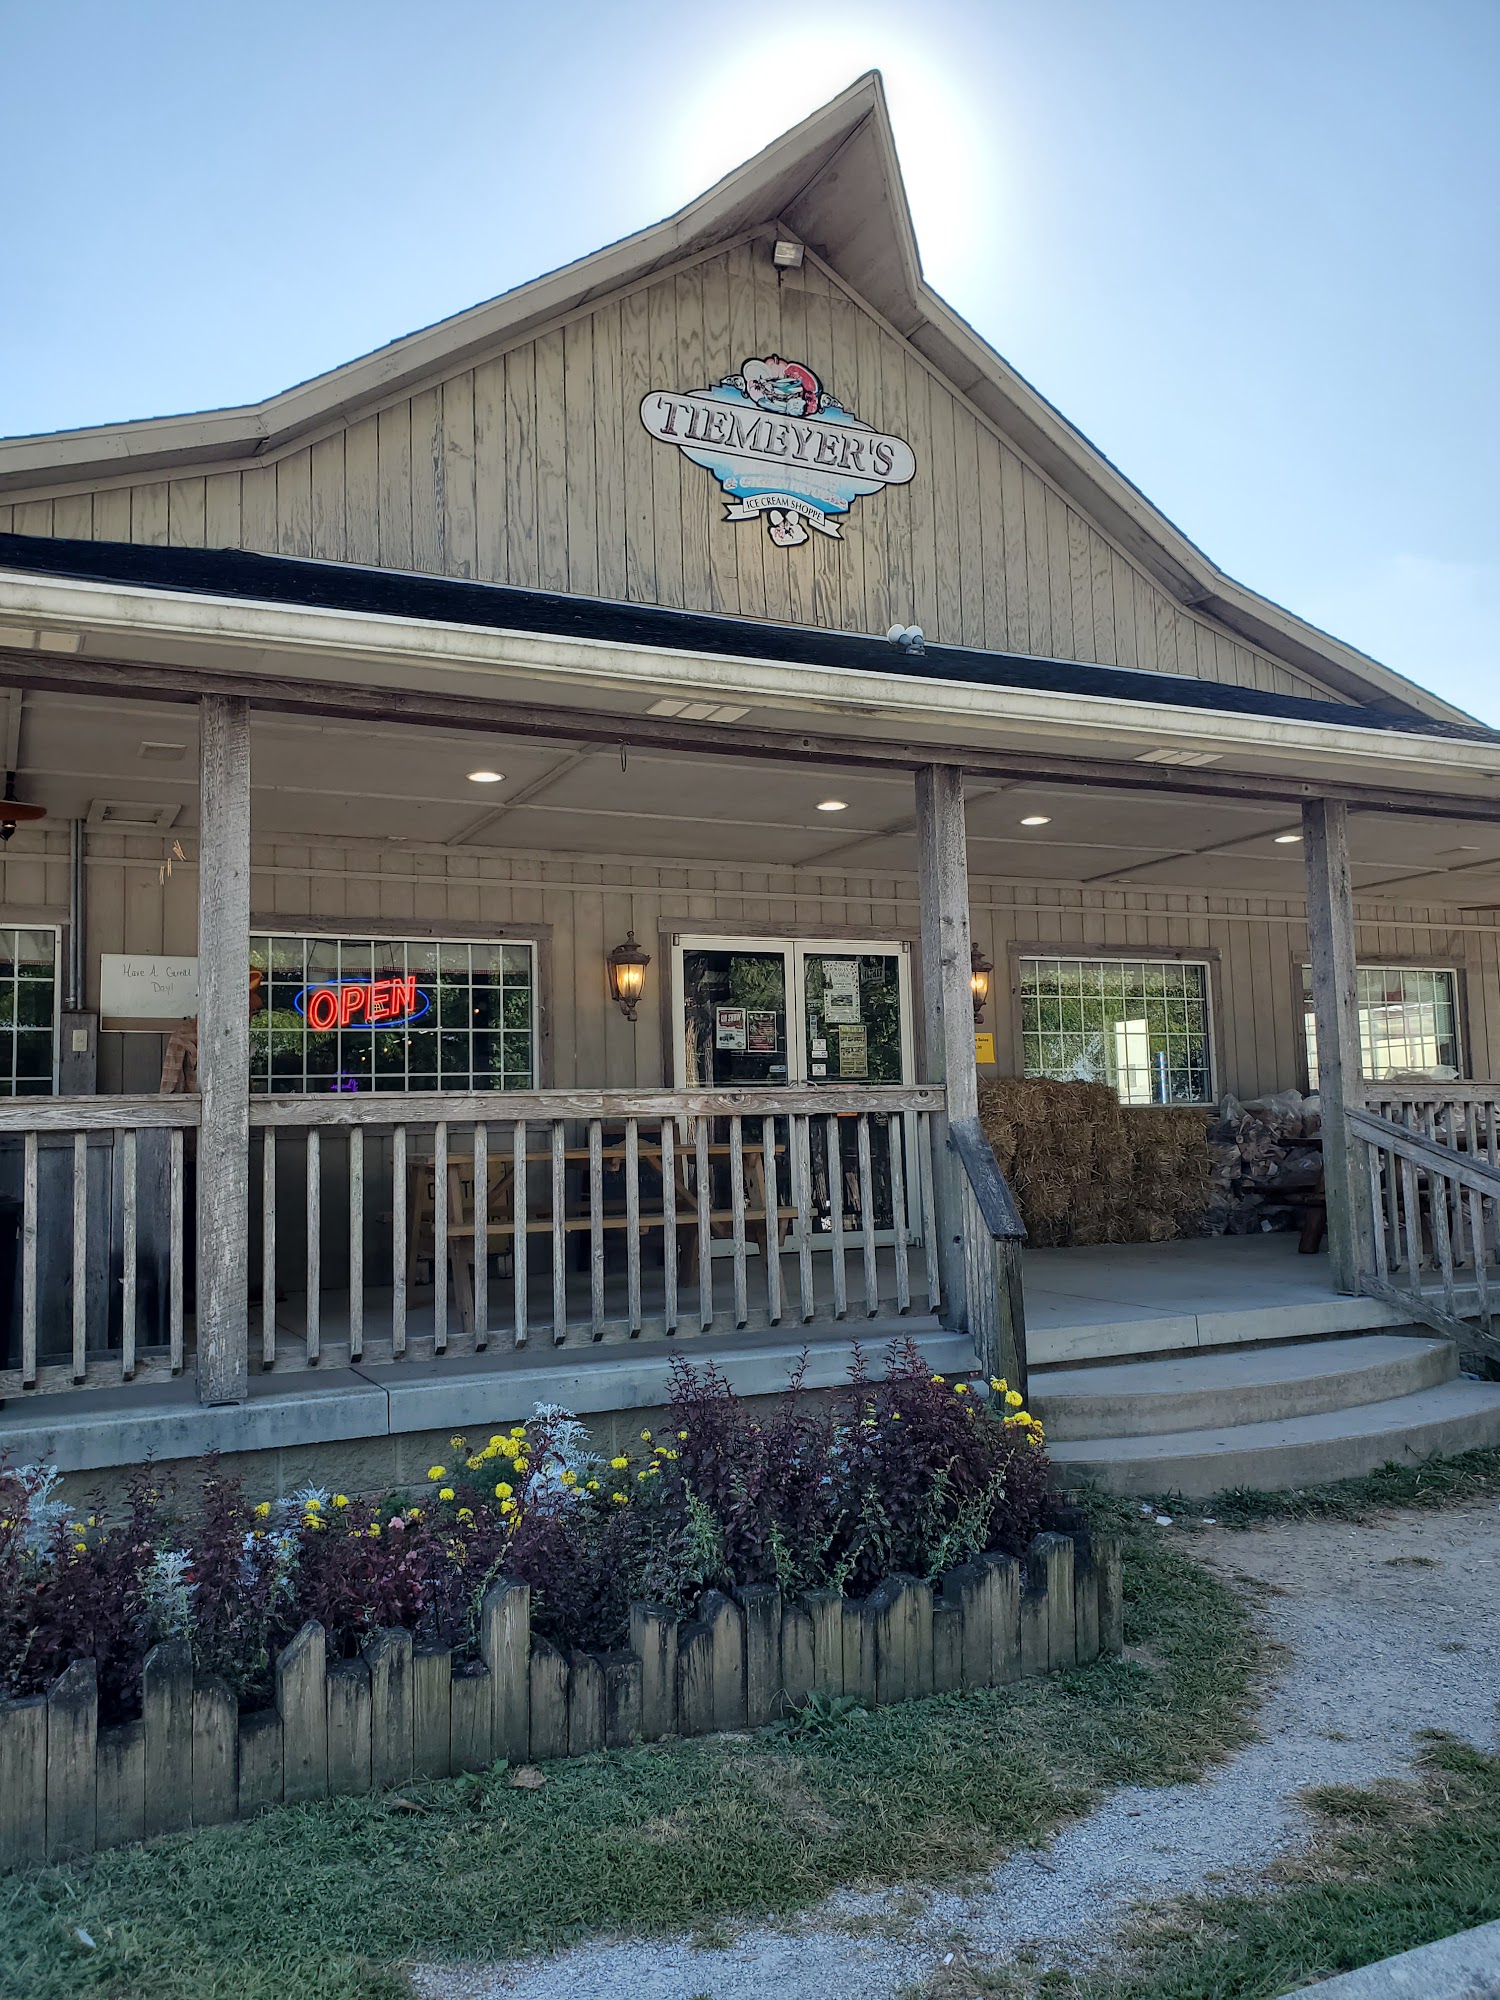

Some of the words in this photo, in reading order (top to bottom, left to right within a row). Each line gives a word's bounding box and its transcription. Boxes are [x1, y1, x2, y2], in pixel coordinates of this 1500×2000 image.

[657, 397, 895, 476] TIEMEYER'S
[746, 499, 760, 510] ICE
[761, 496, 789, 506] CREAM
[791, 500, 823, 521] SHOPPE
[123, 963, 145, 977] Have
[308, 975, 417, 1032] OPEN
